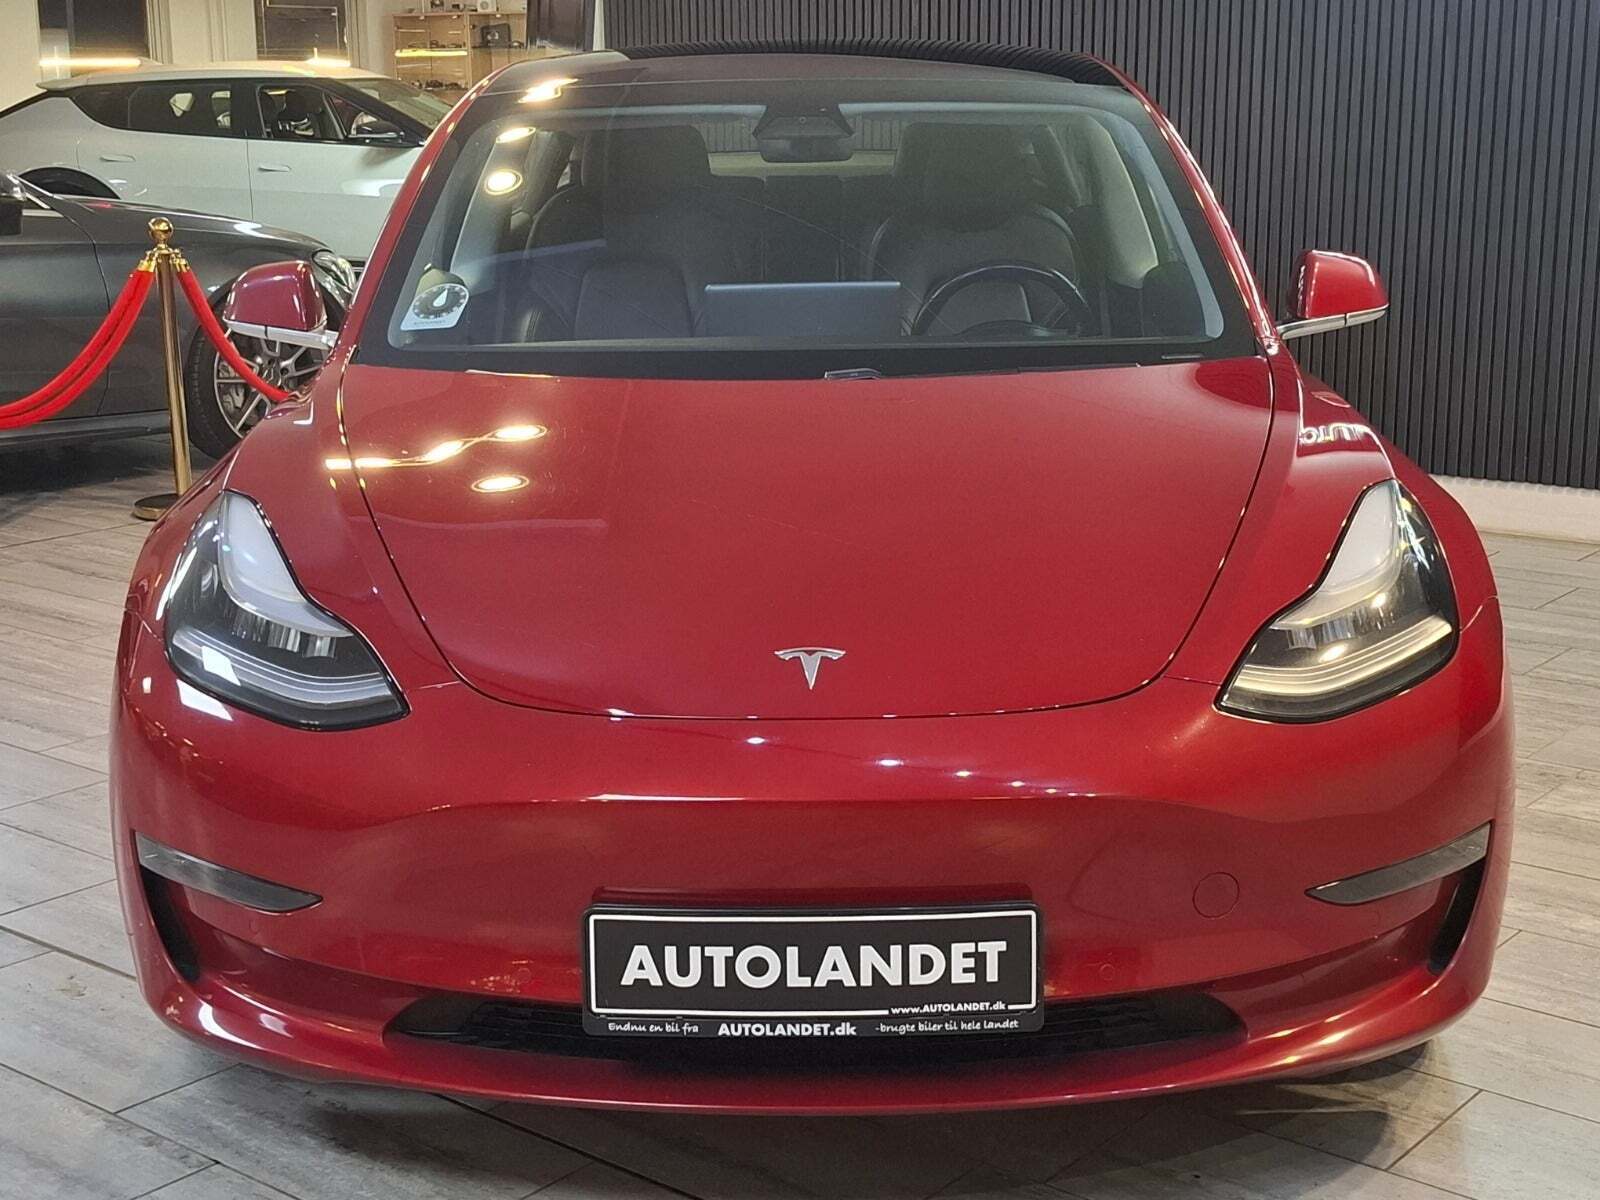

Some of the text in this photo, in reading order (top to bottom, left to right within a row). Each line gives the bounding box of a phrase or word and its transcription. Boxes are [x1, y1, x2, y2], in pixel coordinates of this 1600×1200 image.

[620, 941, 1007, 989] AUTOLANDET
[890, 1001, 1006, 1015] www.AUTOLANDET.dk
[608, 1021, 699, 1036] Endnu en bil fra
[718, 1022, 857, 1036] AUTOLANDET.dk
[918, 1020, 943, 1031] biler
[944, 1019, 958, 1030] til
[960, 1020, 981, 1030] hele
[983, 1018, 1019, 1029] landet
